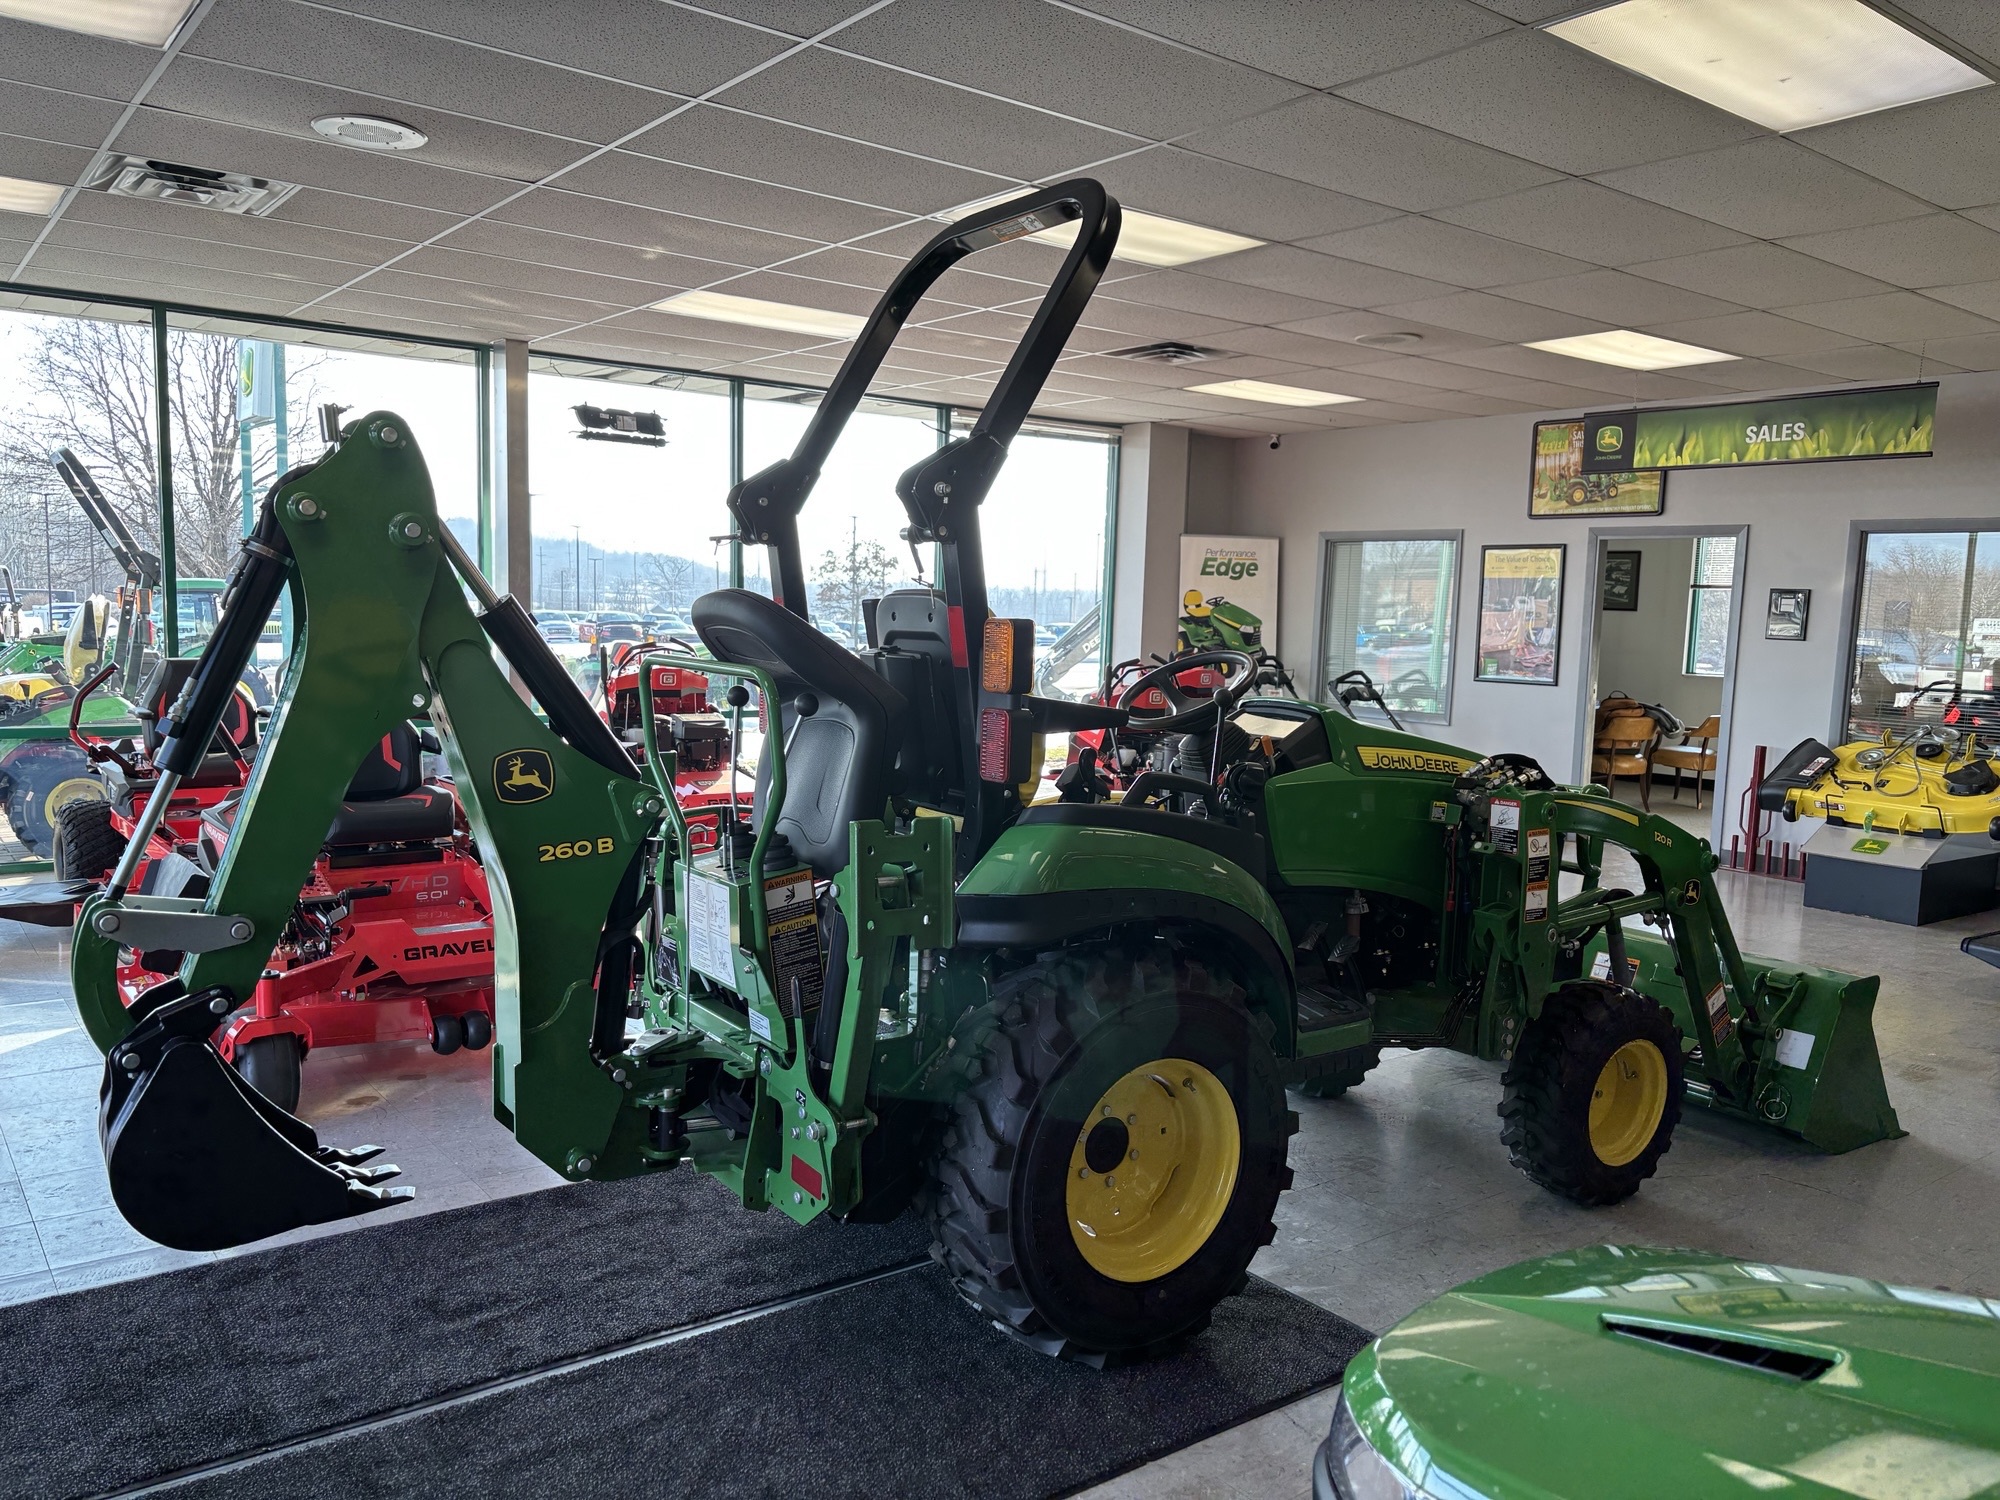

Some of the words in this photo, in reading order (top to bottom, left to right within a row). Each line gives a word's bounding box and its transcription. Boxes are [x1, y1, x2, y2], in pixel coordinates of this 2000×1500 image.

[1745, 422, 1806, 444] SALES
[1204, 548, 1257, 558] Performance
[1495, 555, 1505, 563] The
[1506, 555, 1522, 563] Value
[1523, 555, 1529, 563] of
[1200, 557, 1259, 581] Edge
[1371, 752, 1412, 769] JOHN
[1414, 754, 1461, 774] DEERE
[538, 842, 593, 862] 260
[597, 836, 615, 855] B
[774, 873, 808, 888] WARNING
[780, 918, 812, 932] CAUTION
